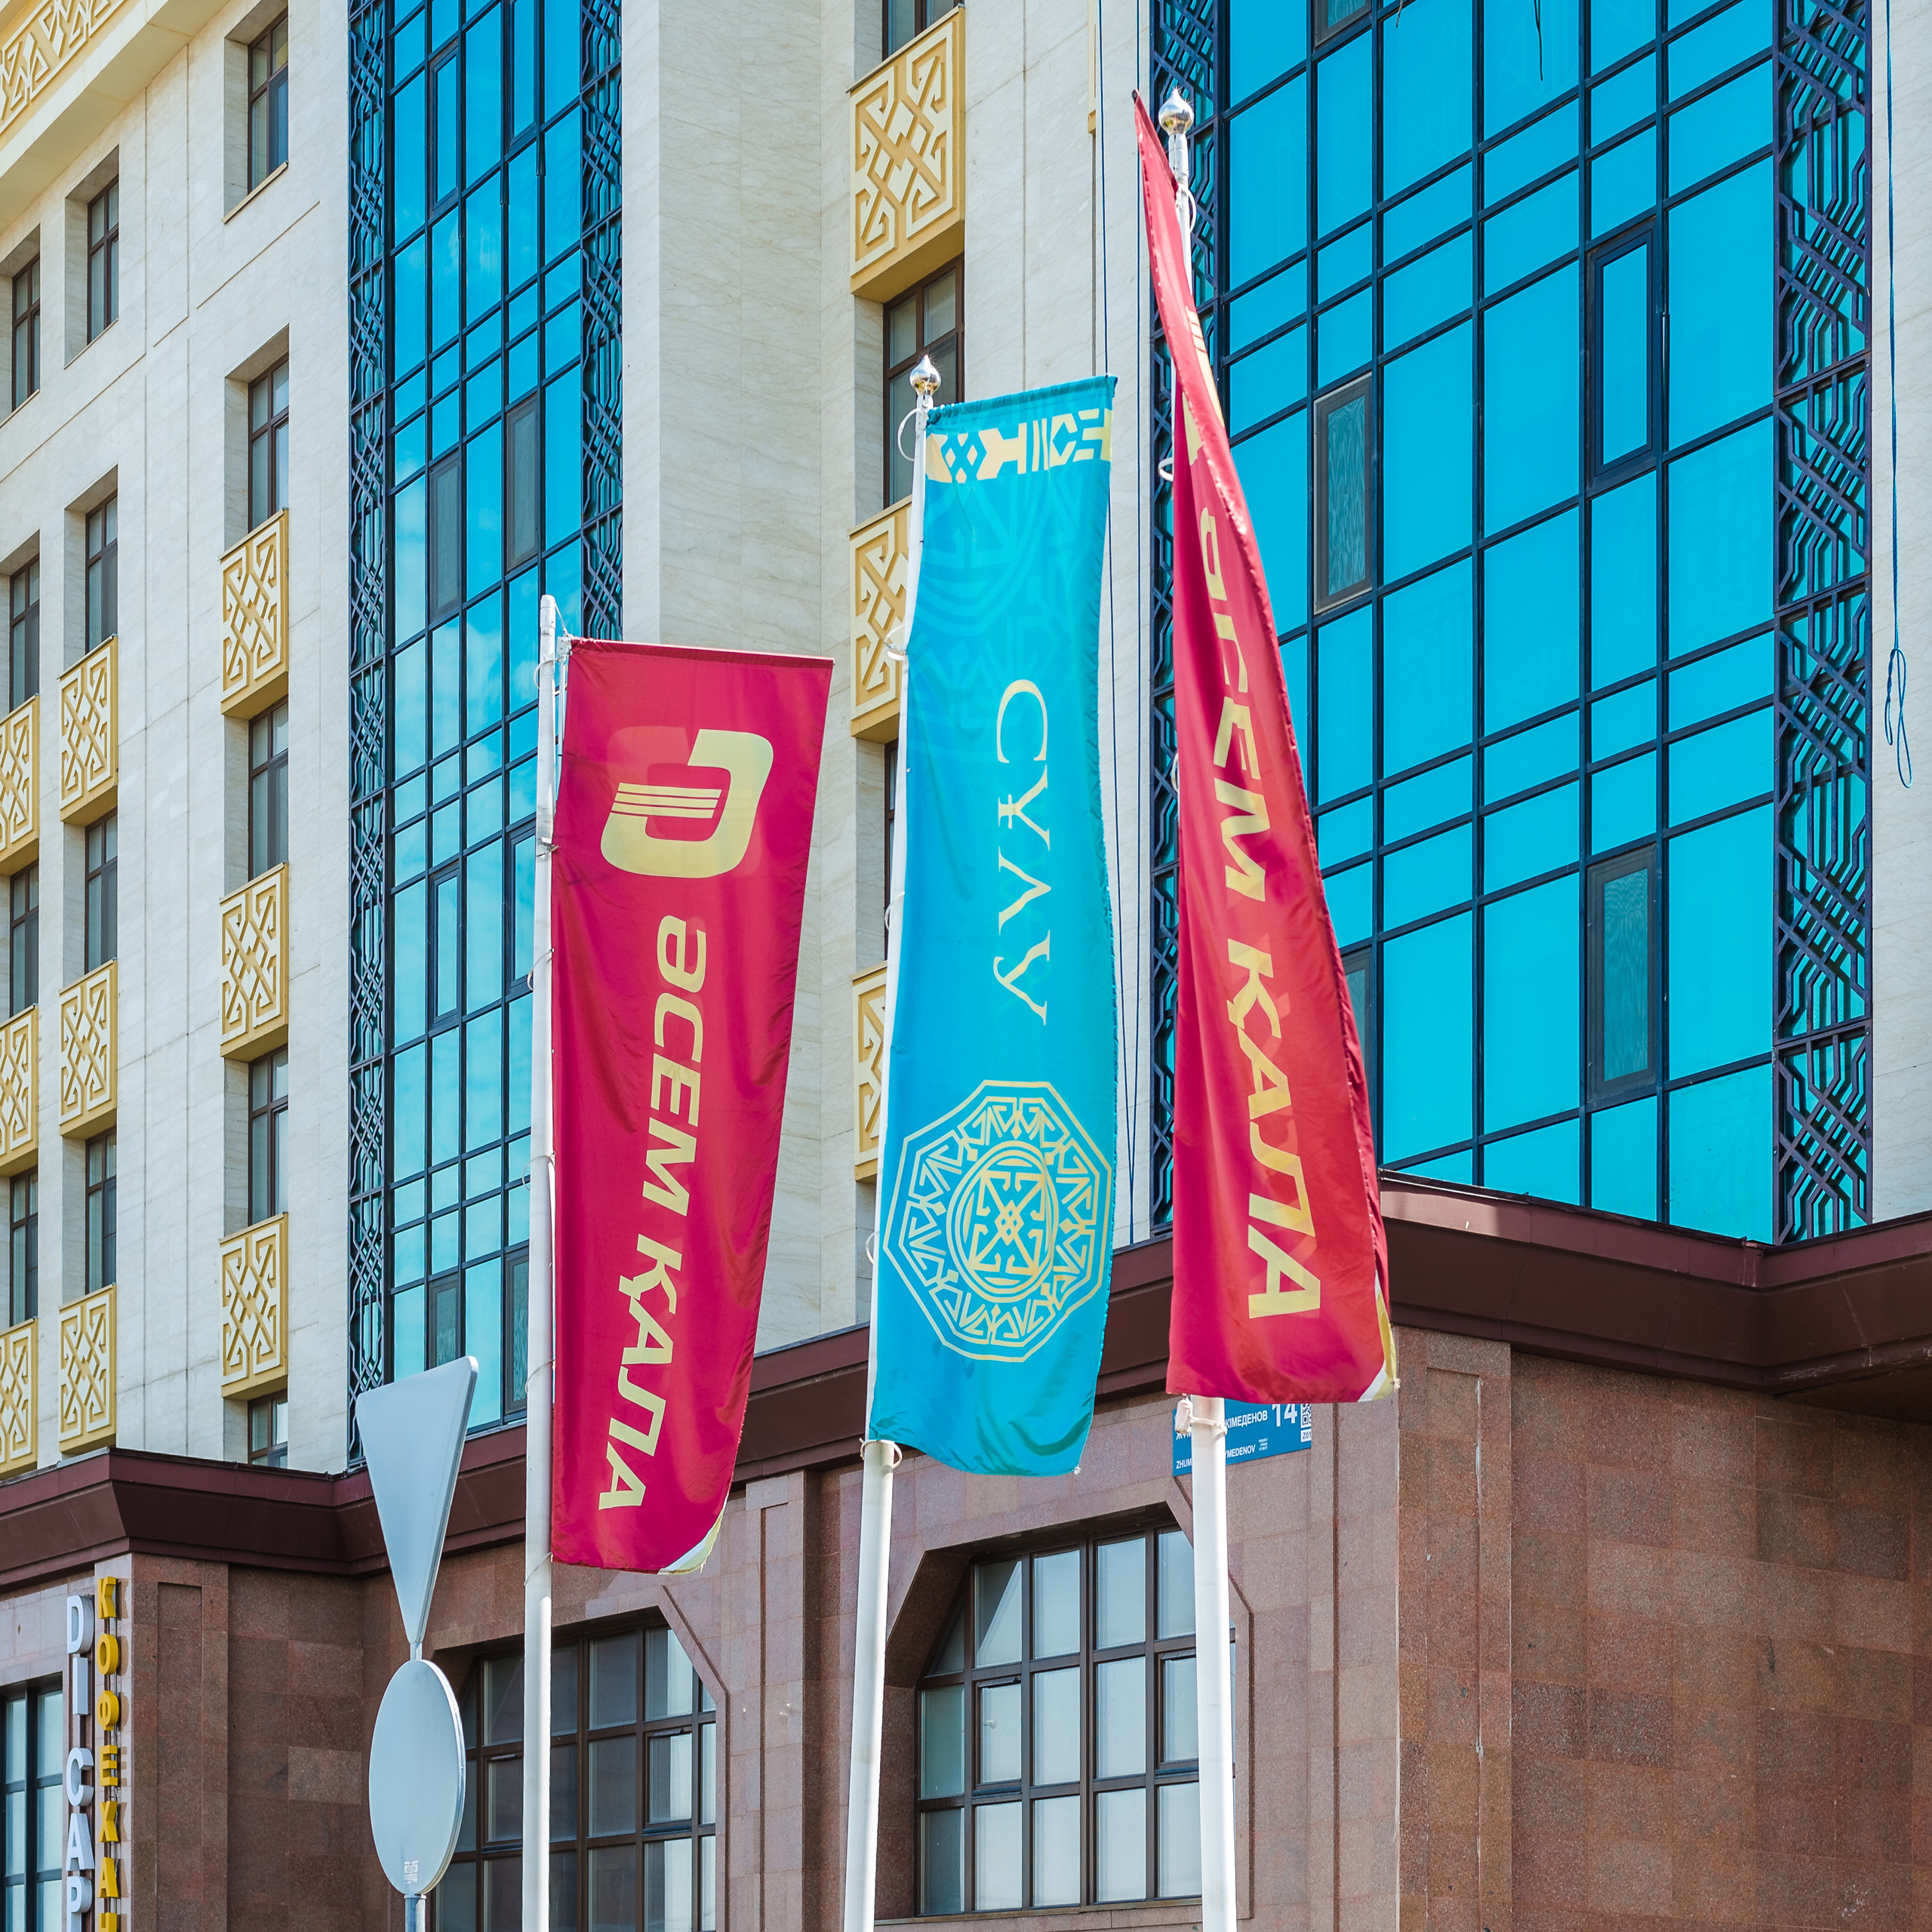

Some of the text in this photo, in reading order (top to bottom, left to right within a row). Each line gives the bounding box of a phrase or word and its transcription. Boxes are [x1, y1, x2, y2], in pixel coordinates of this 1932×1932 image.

[1226, 938, 1321, 1319] ҚАЛА
[598, 1233, 682, 1509] ҚАЛА
[1272, 1404, 1297, 1427] 14
